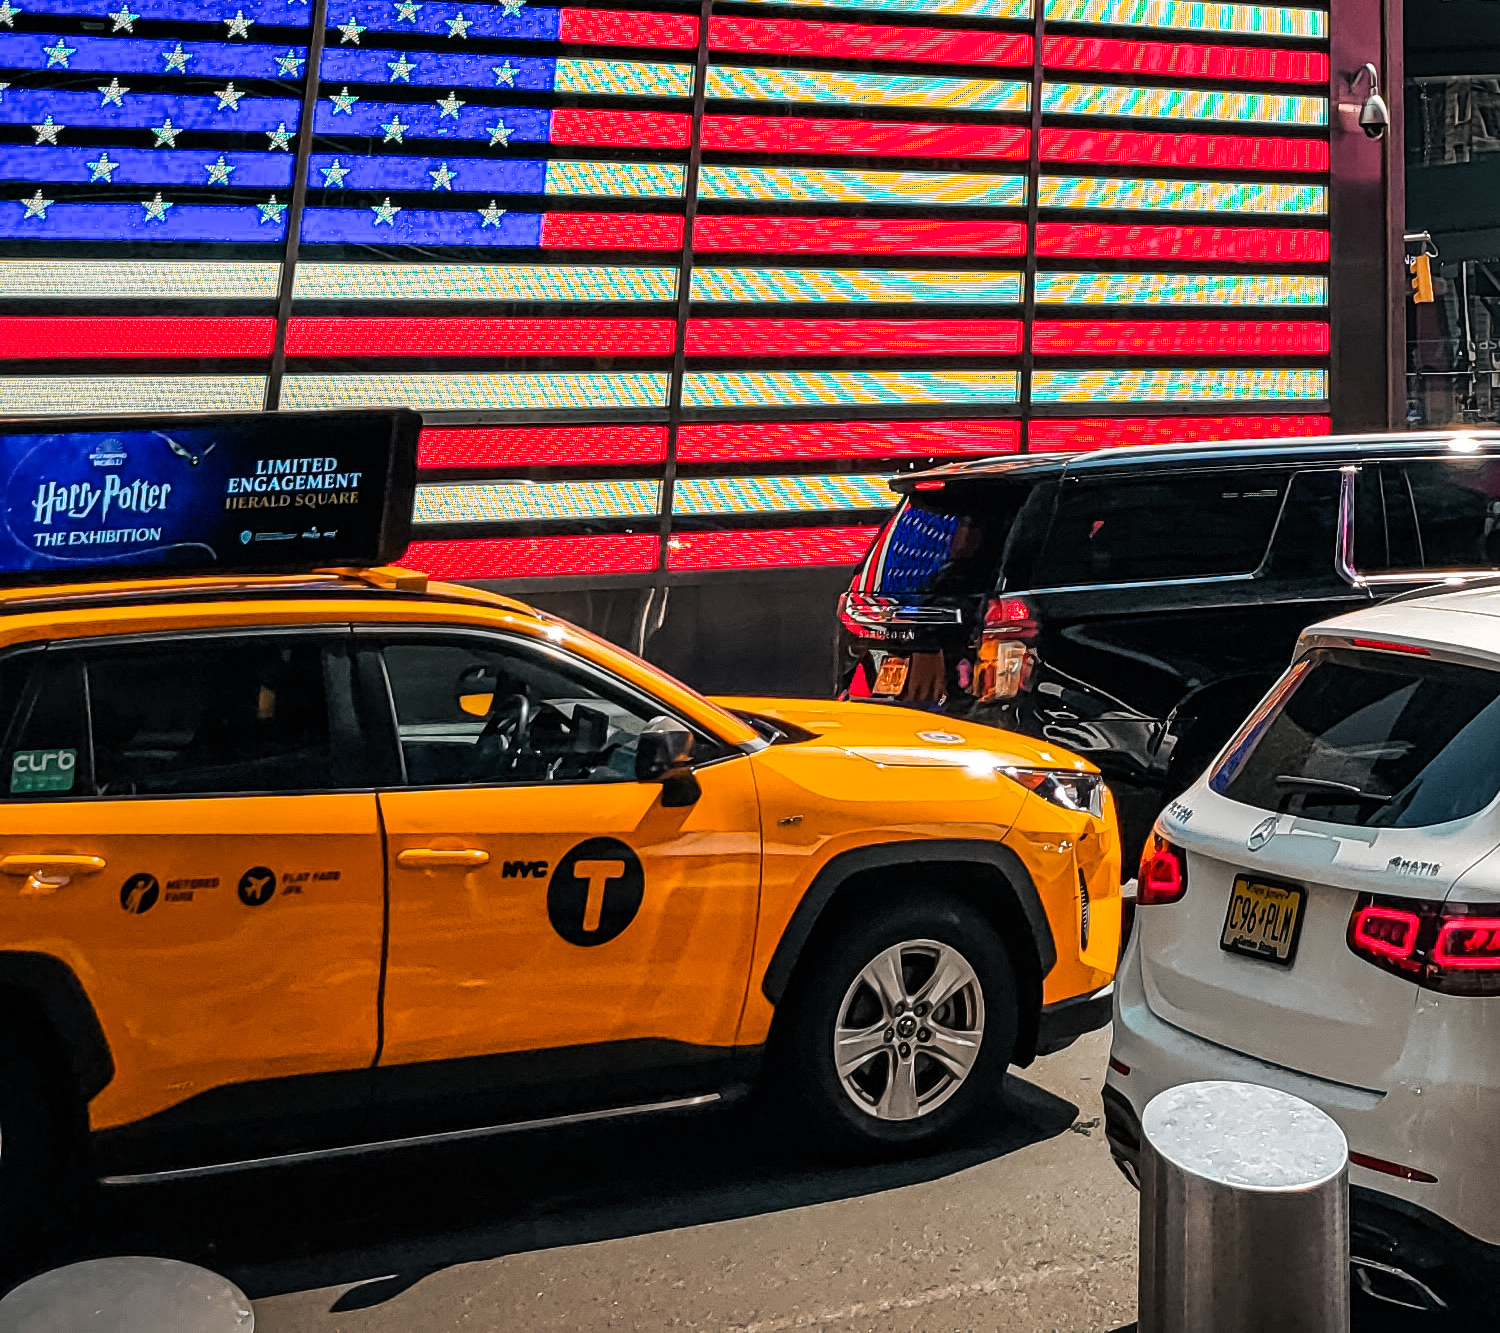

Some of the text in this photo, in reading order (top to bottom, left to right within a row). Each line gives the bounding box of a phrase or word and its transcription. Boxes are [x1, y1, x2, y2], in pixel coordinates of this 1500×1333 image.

[255, 457, 338, 475] LIMITED
[227, 472, 362, 493] ENGAGEMENT
[31, 474, 172, 525] Harry Potter
[225, 491, 360, 510] HERALD SQUARE
[33, 526, 162, 547] THE EXHIBITION
[14, 750, 75, 772] curb
[502, 860, 549, 878] NYC
